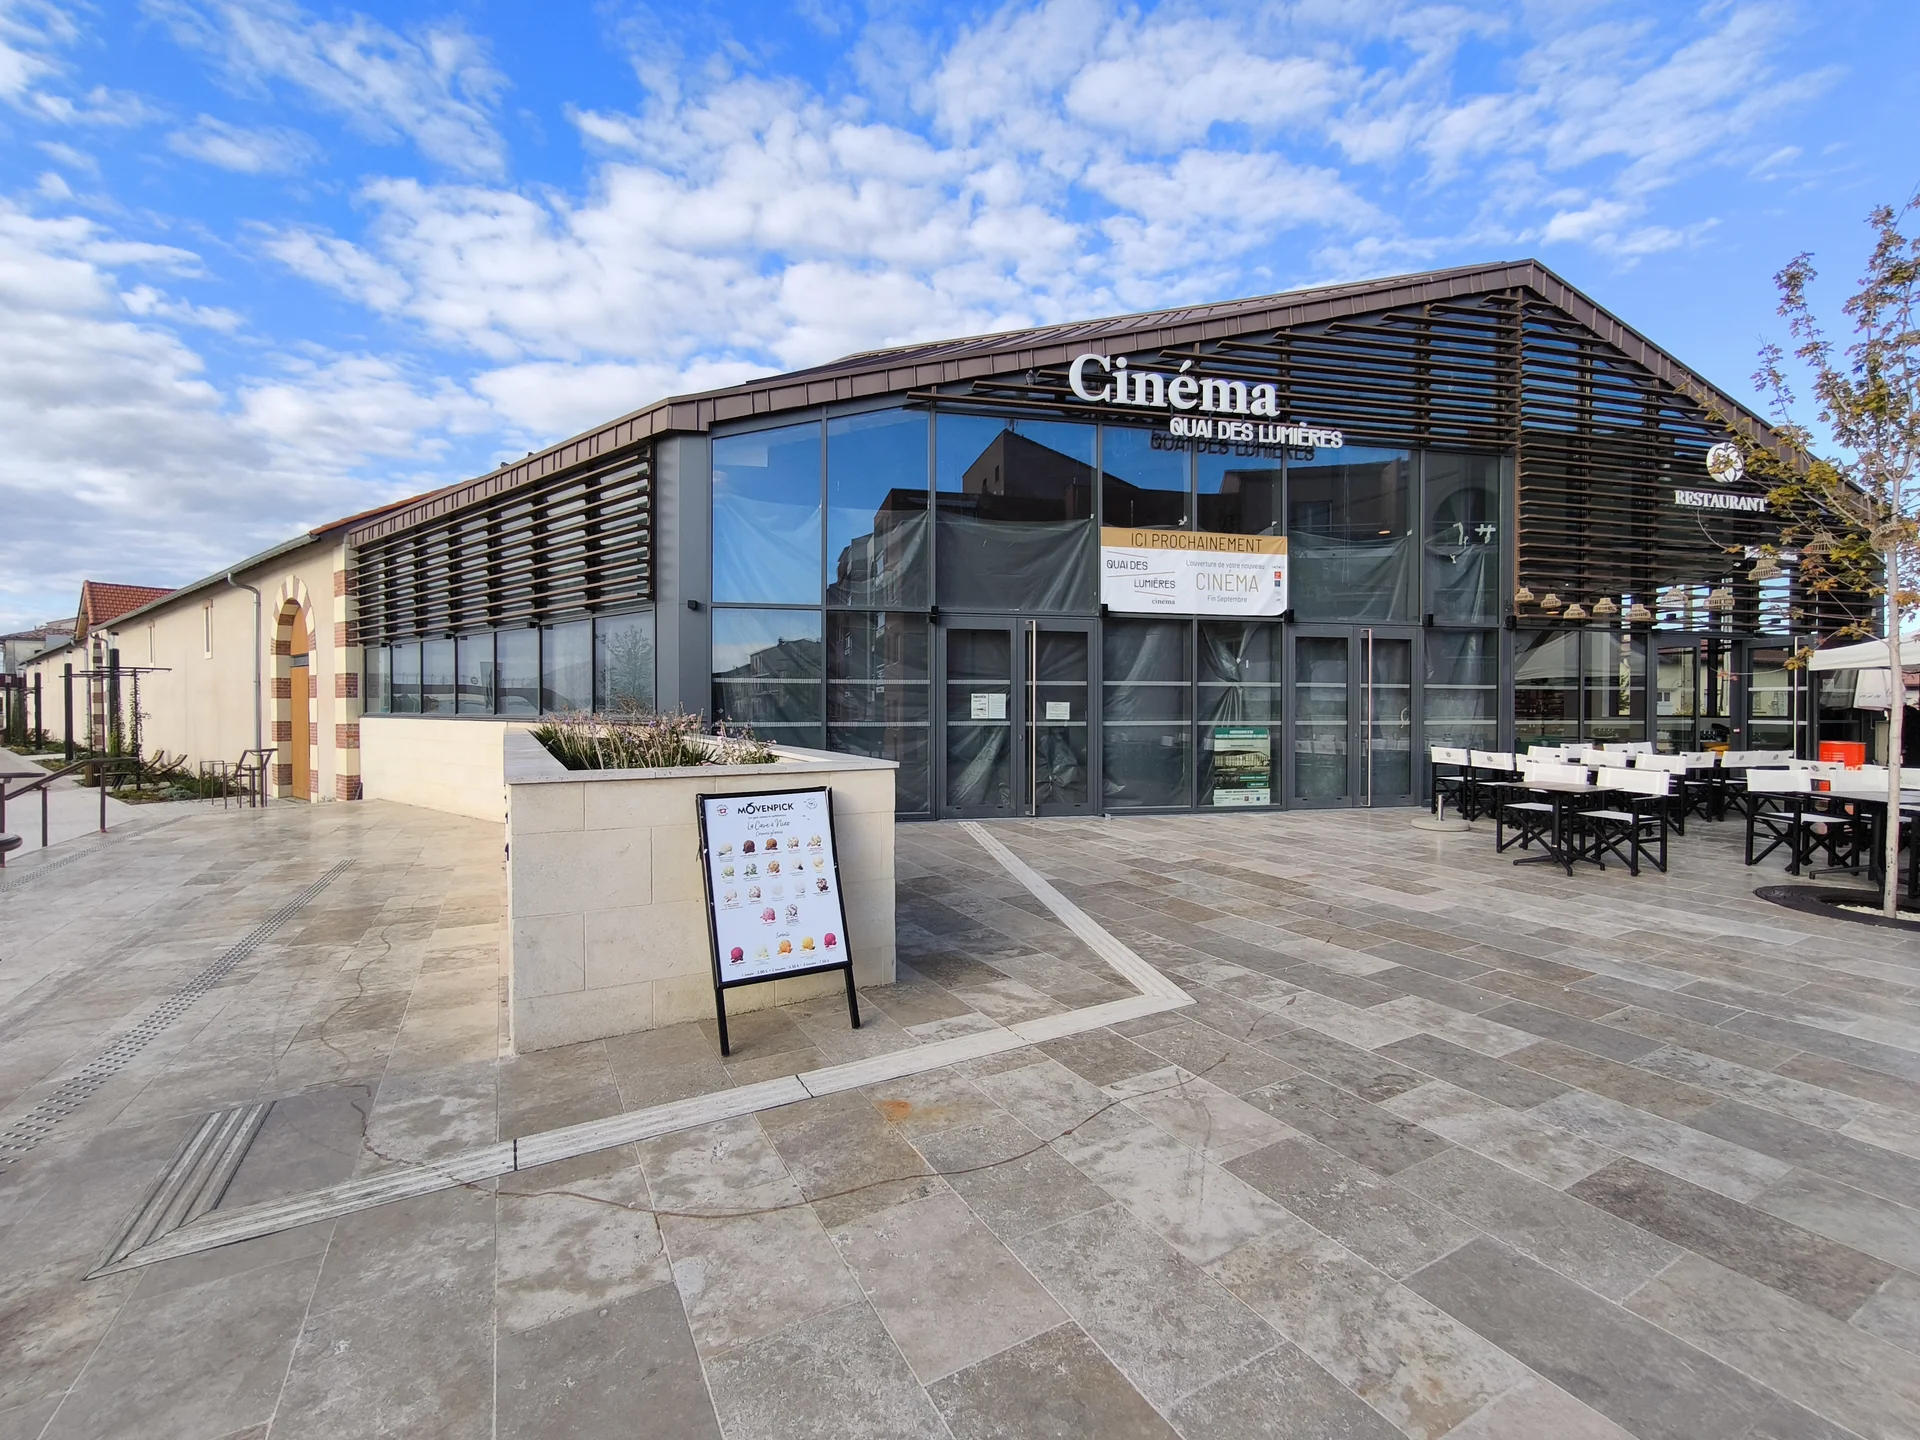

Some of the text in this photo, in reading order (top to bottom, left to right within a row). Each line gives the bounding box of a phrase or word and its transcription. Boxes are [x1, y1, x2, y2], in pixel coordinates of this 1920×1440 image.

[1068, 353, 1280, 417] Cinéma
[1170, 417, 1343, 449] QUAI DES LUMIÈRES
[1674, 490, 1768, 512] RESTAURANT
[1131, 532, 1262, 553] ICI PROCHAINEMENT
[1106, 560, 1148, 571] QUAI DES
[1186, 560, 1217, 569] L'ouverture
[1217, 561, 1225, 569] de
[1134, 577, 1176, 589] LUMIÈRES
[1195, 569, 1259, 593] CINÉMA
[1217, 595, 1248, 604] Septembre
